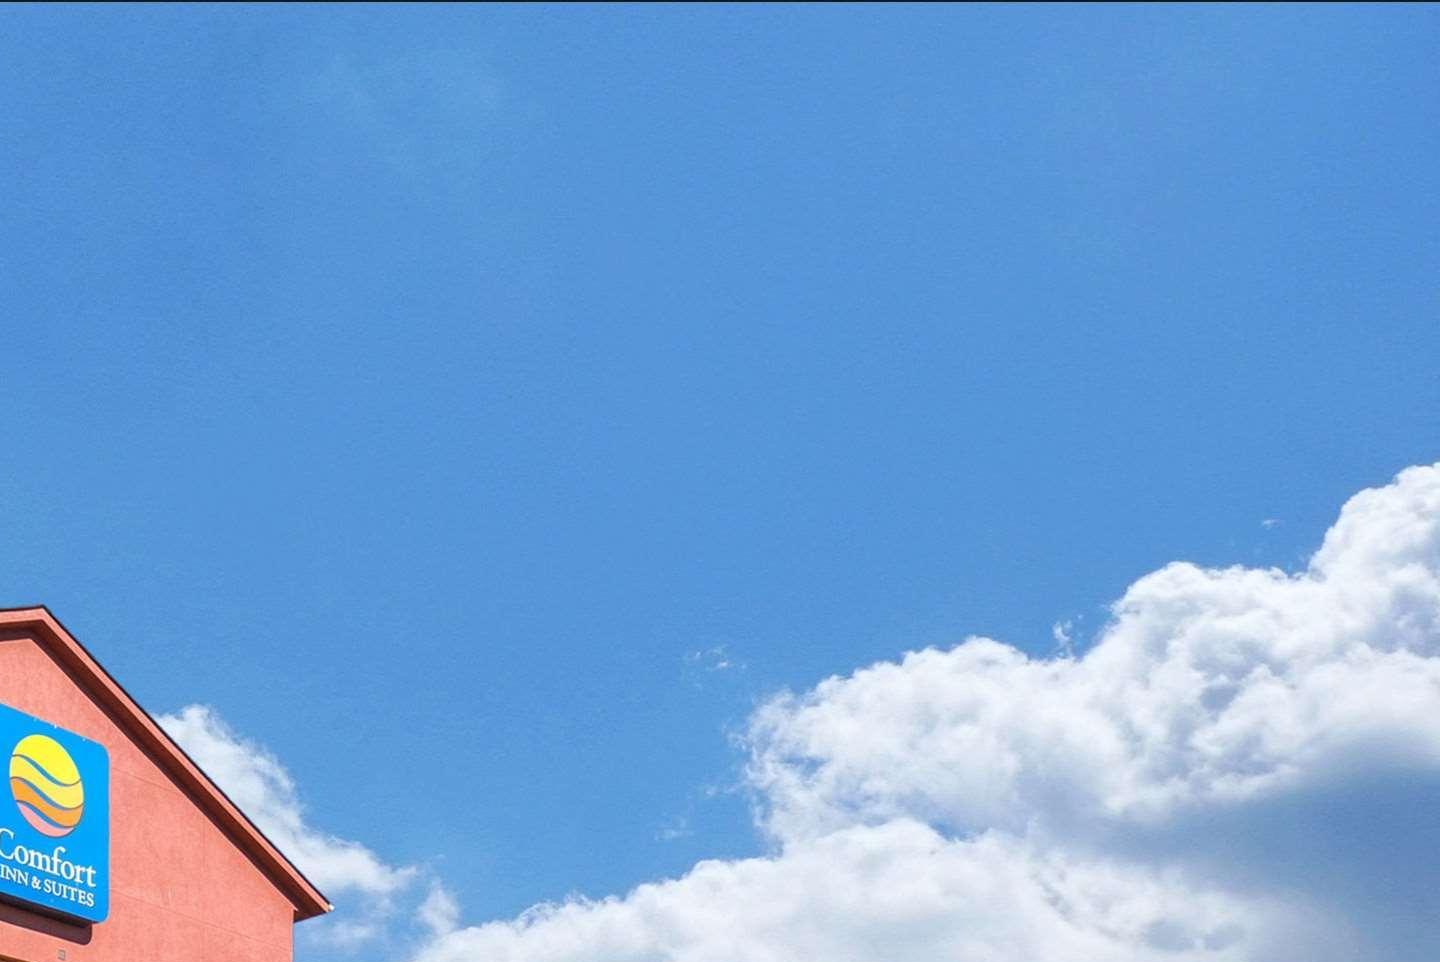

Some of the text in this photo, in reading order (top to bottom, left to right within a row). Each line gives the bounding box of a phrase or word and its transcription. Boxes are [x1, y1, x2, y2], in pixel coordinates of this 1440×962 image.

[0, 863, 95, 907] INN & SUITES
